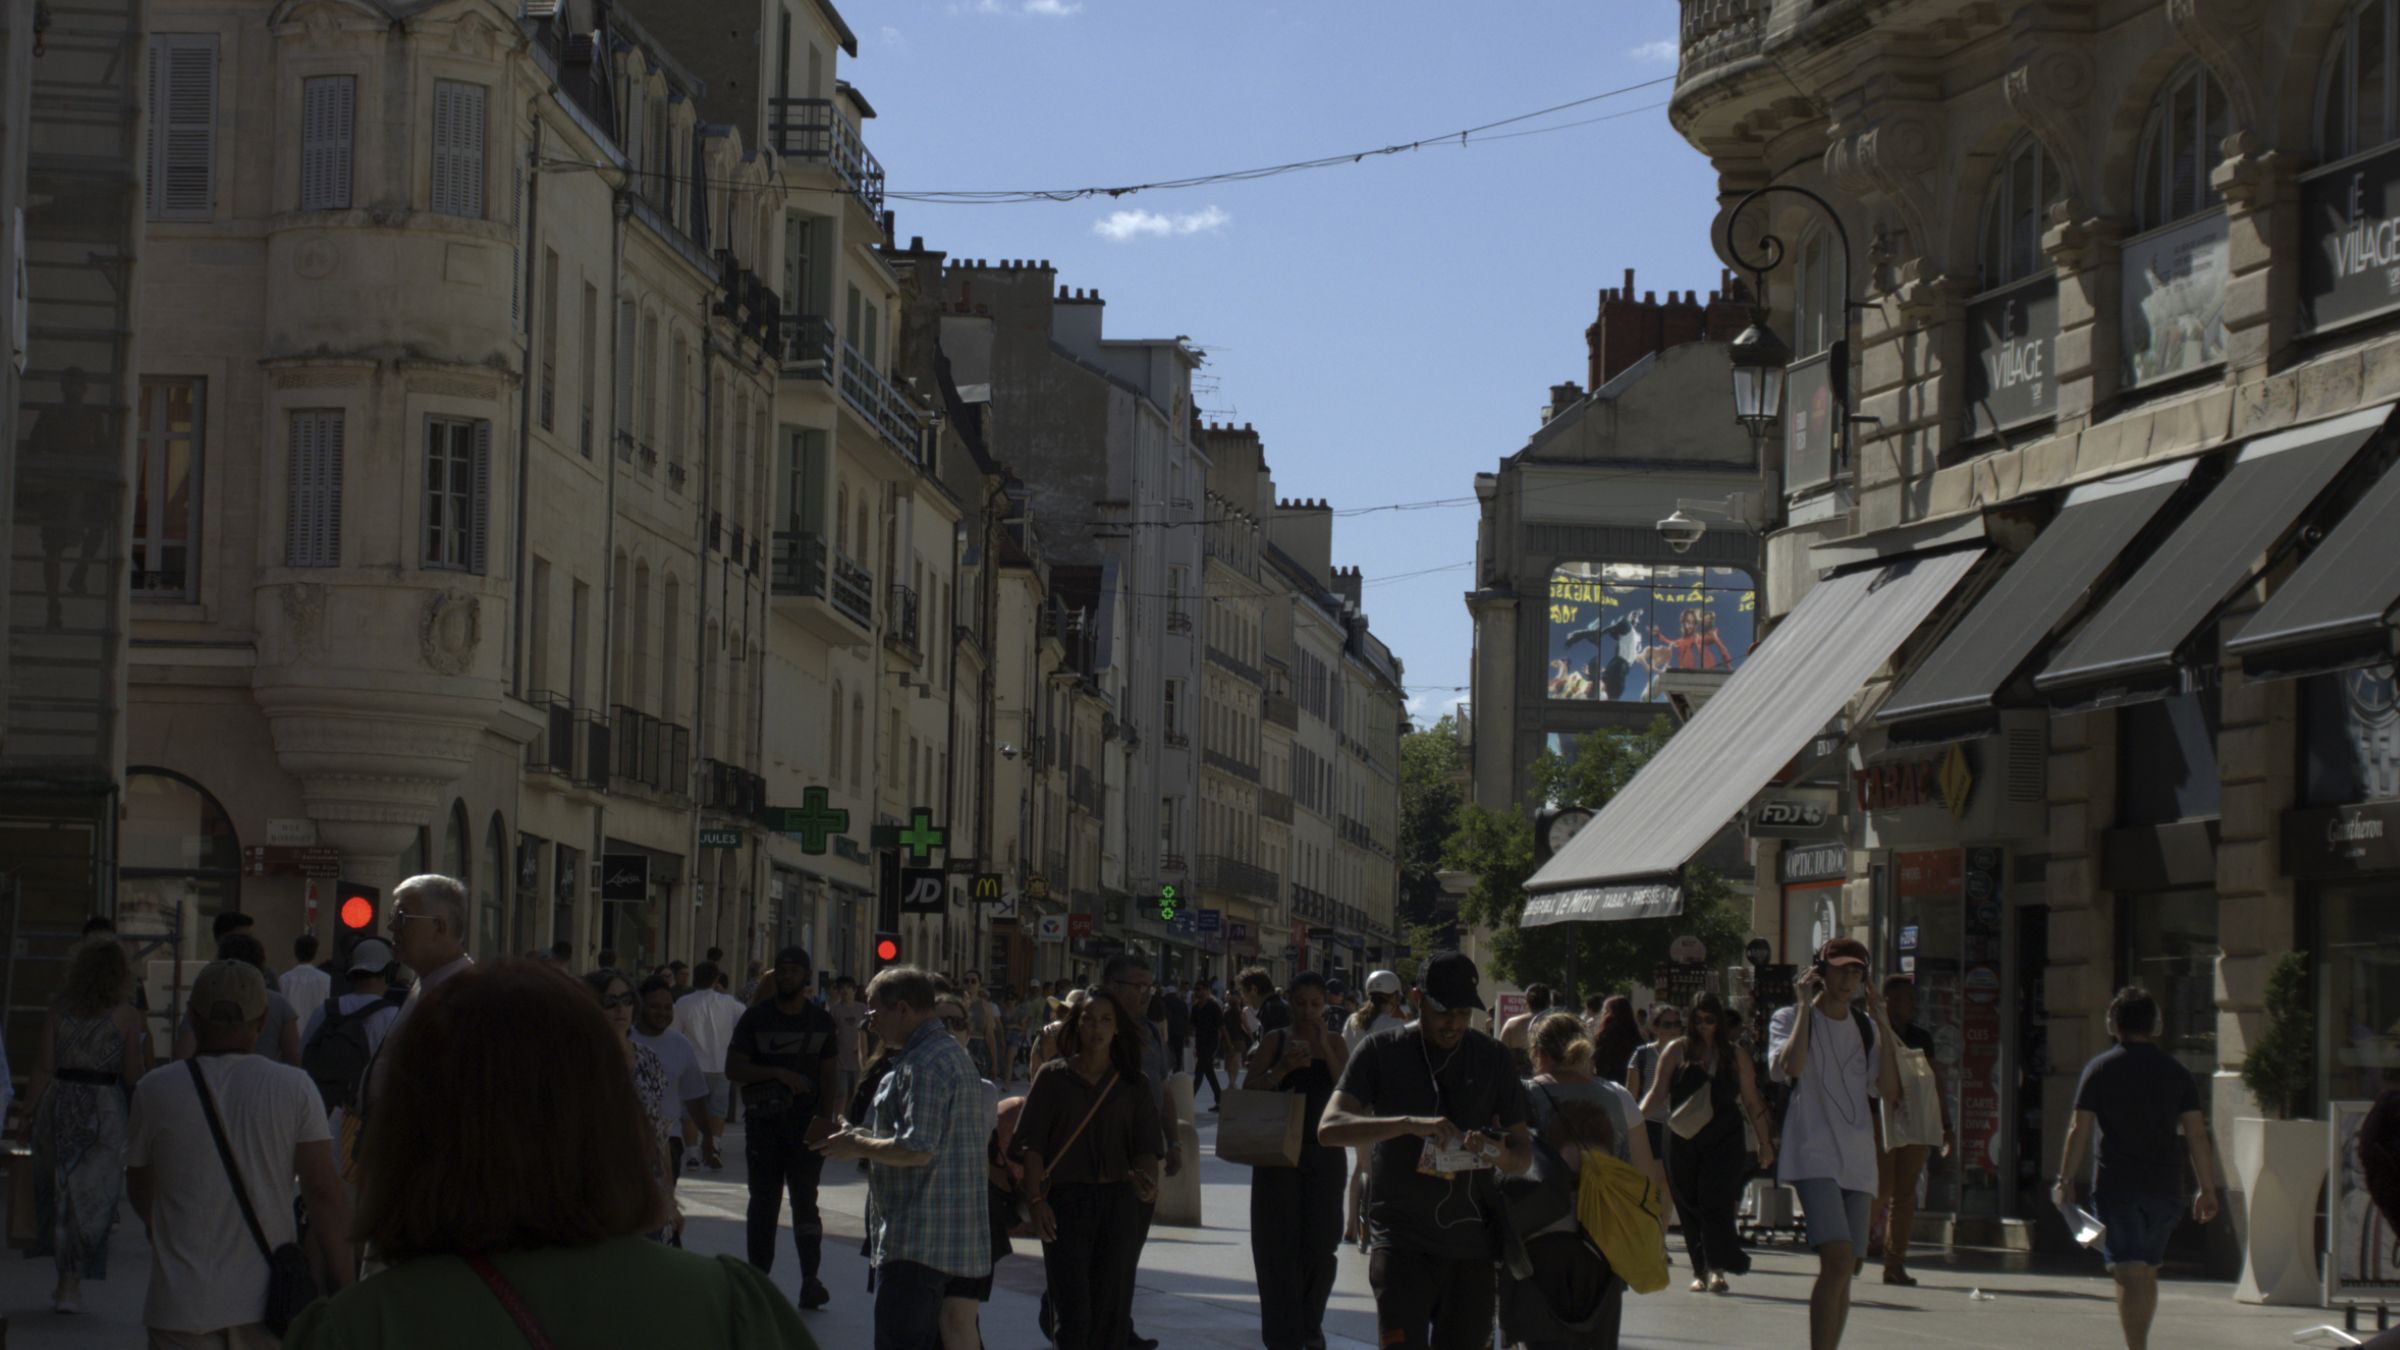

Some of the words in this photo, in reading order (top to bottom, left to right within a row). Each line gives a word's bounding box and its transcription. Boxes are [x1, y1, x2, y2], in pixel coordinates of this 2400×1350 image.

[2349, 171, 2366, 226] LE
[2334, 216, 2400, 278] VILLAGE
[2002, 298, 2016, 343] LE
[1991, 338, 2043, 391] VILLAGE
[1761, 803, 1798, 823] FDJ
[701, 834, 736, 845] JULES
[1786, 852, 1814, 878] OPTIC
[904, 877, 942, 903] JD
[1072, 921, 1090, 931] SFR
